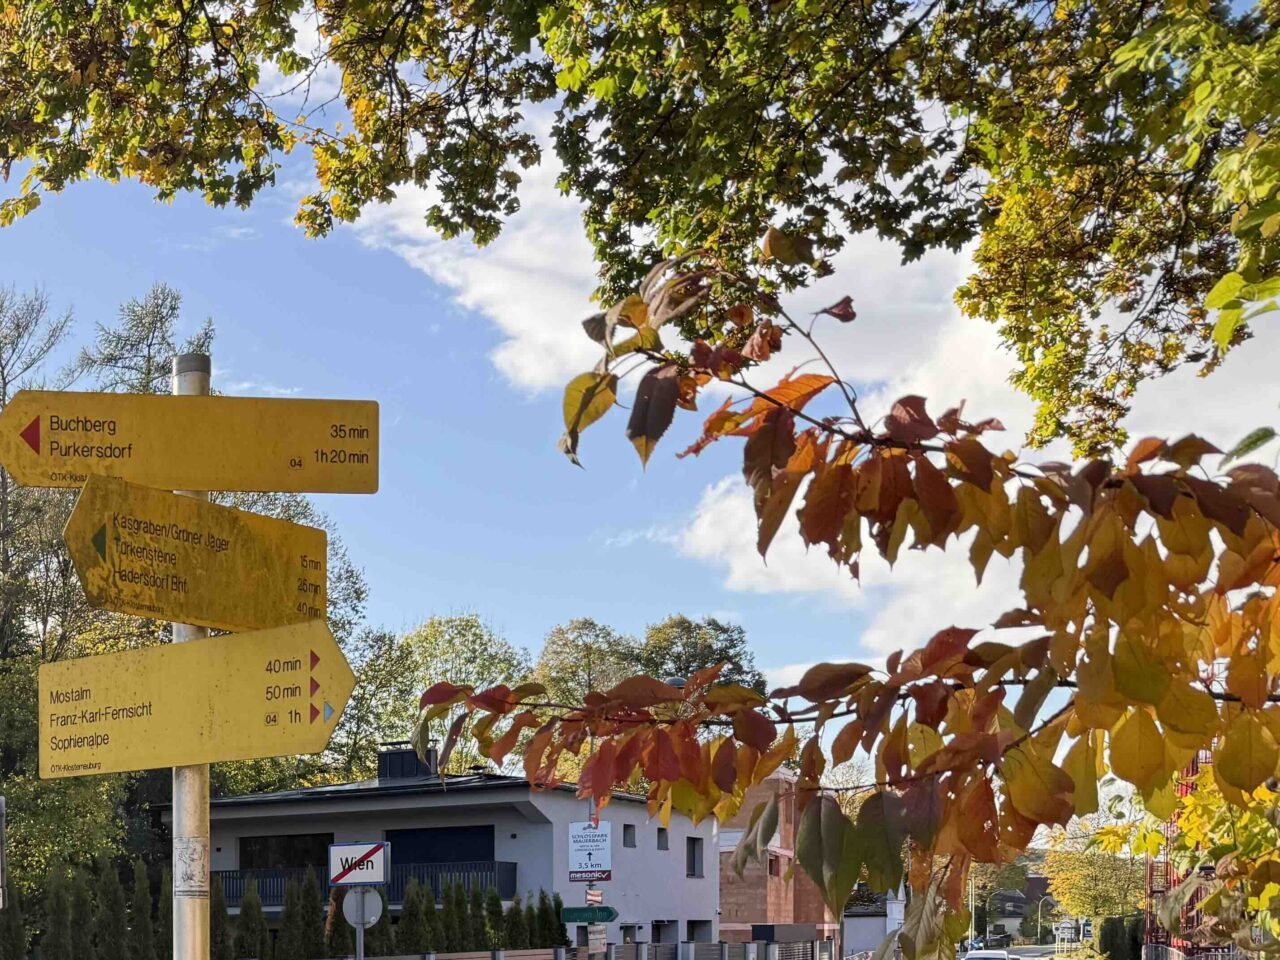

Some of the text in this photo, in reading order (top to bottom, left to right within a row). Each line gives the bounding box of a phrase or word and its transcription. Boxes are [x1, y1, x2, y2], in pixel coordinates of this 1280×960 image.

[49, 415, 117, 436] Buchberg
[330, 424, 369, 439] 35 min
[49, 441, 133, 459] Purkersdorf
[314, 449, 369, 464] 1h 20 min
[289, 456, 303, 468] 04
[308, 559, 322, 572] min
[113, 567, 169, 590] Hadersdorf
[309, 582, 321, 595] min
[297, 602, 321, 619] 40 min
[265, 656, 301, 674] 40 min
[49, 686, 91, 705] Mostalm
[265, 683, 301, 701] 50 min
[49, 701, 153, 728] Franz-Karl-Fernsicht
[265, 709, 301, 724] 04 1h
[49, 732, 110, 753] Sophienalpe
[340, 856, 374, 871] Wien
[578, 862, 589, 870] 3,5
